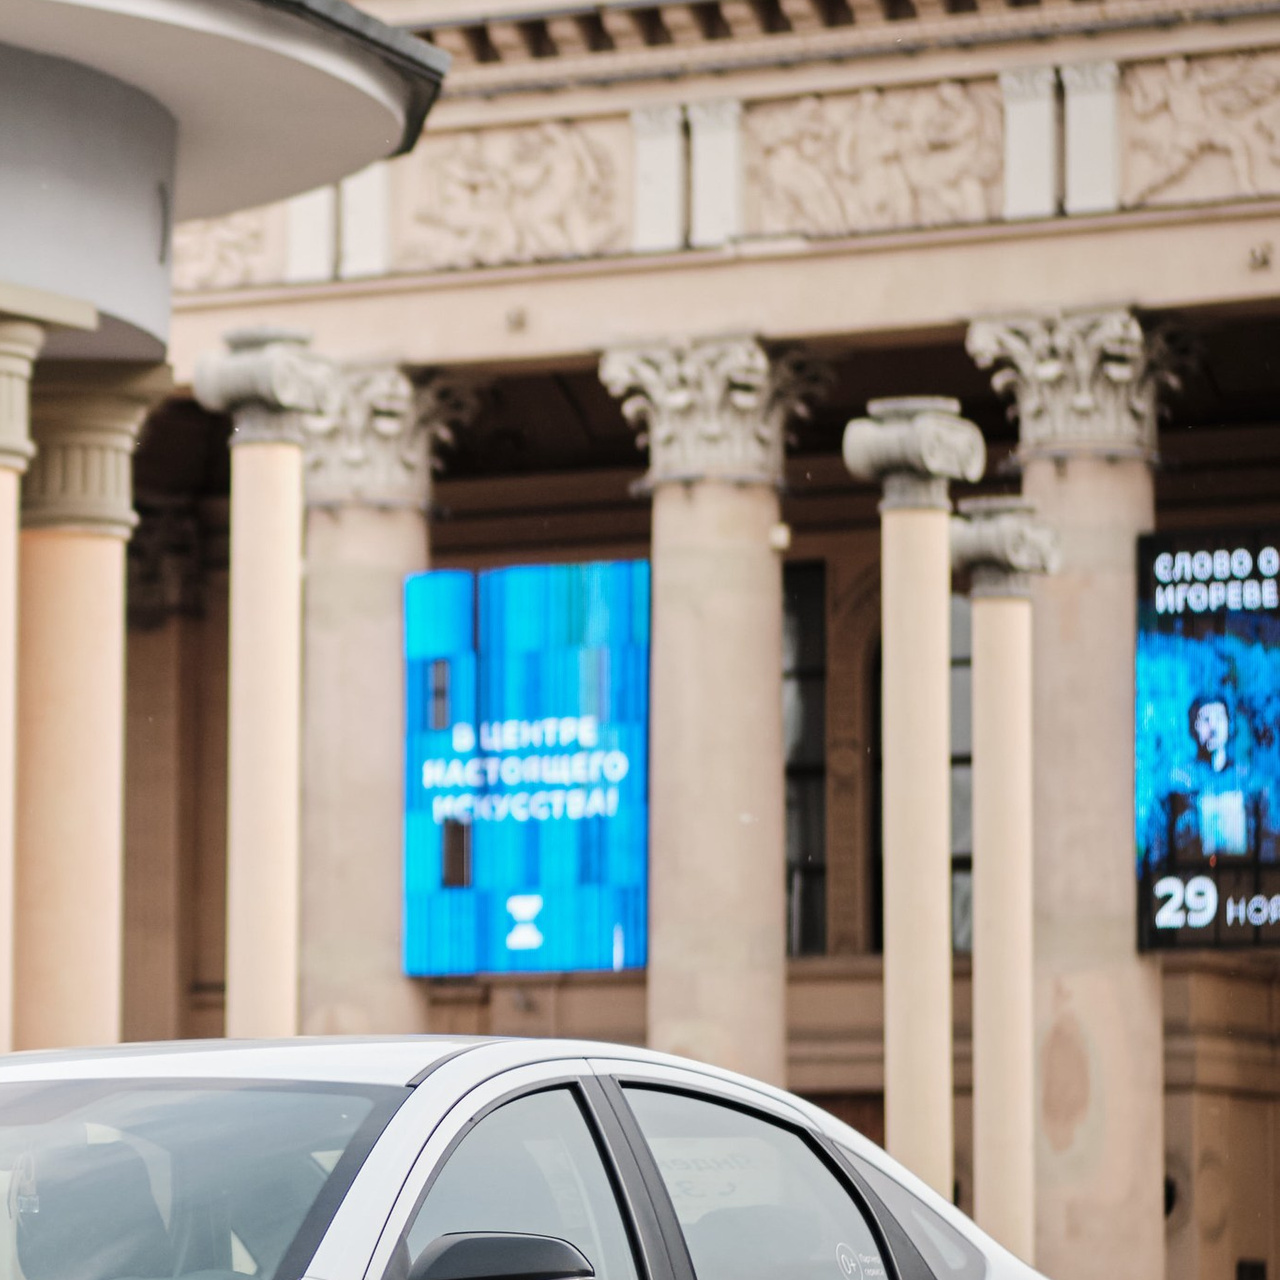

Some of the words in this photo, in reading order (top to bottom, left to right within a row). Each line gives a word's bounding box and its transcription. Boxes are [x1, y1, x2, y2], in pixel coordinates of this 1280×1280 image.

[1154, 547, 1253, 584] СЛОВО
[1257, 546, 1280, 578] О
[1155, 578, 1279, 615] ИГОРЕВЕ
[479, 715, 599, 752] ЦЕНТРЕ
[422, 750, 629, 789] НАСТОЯЩЕГО
[1153, 875, 1218, 929] 29
